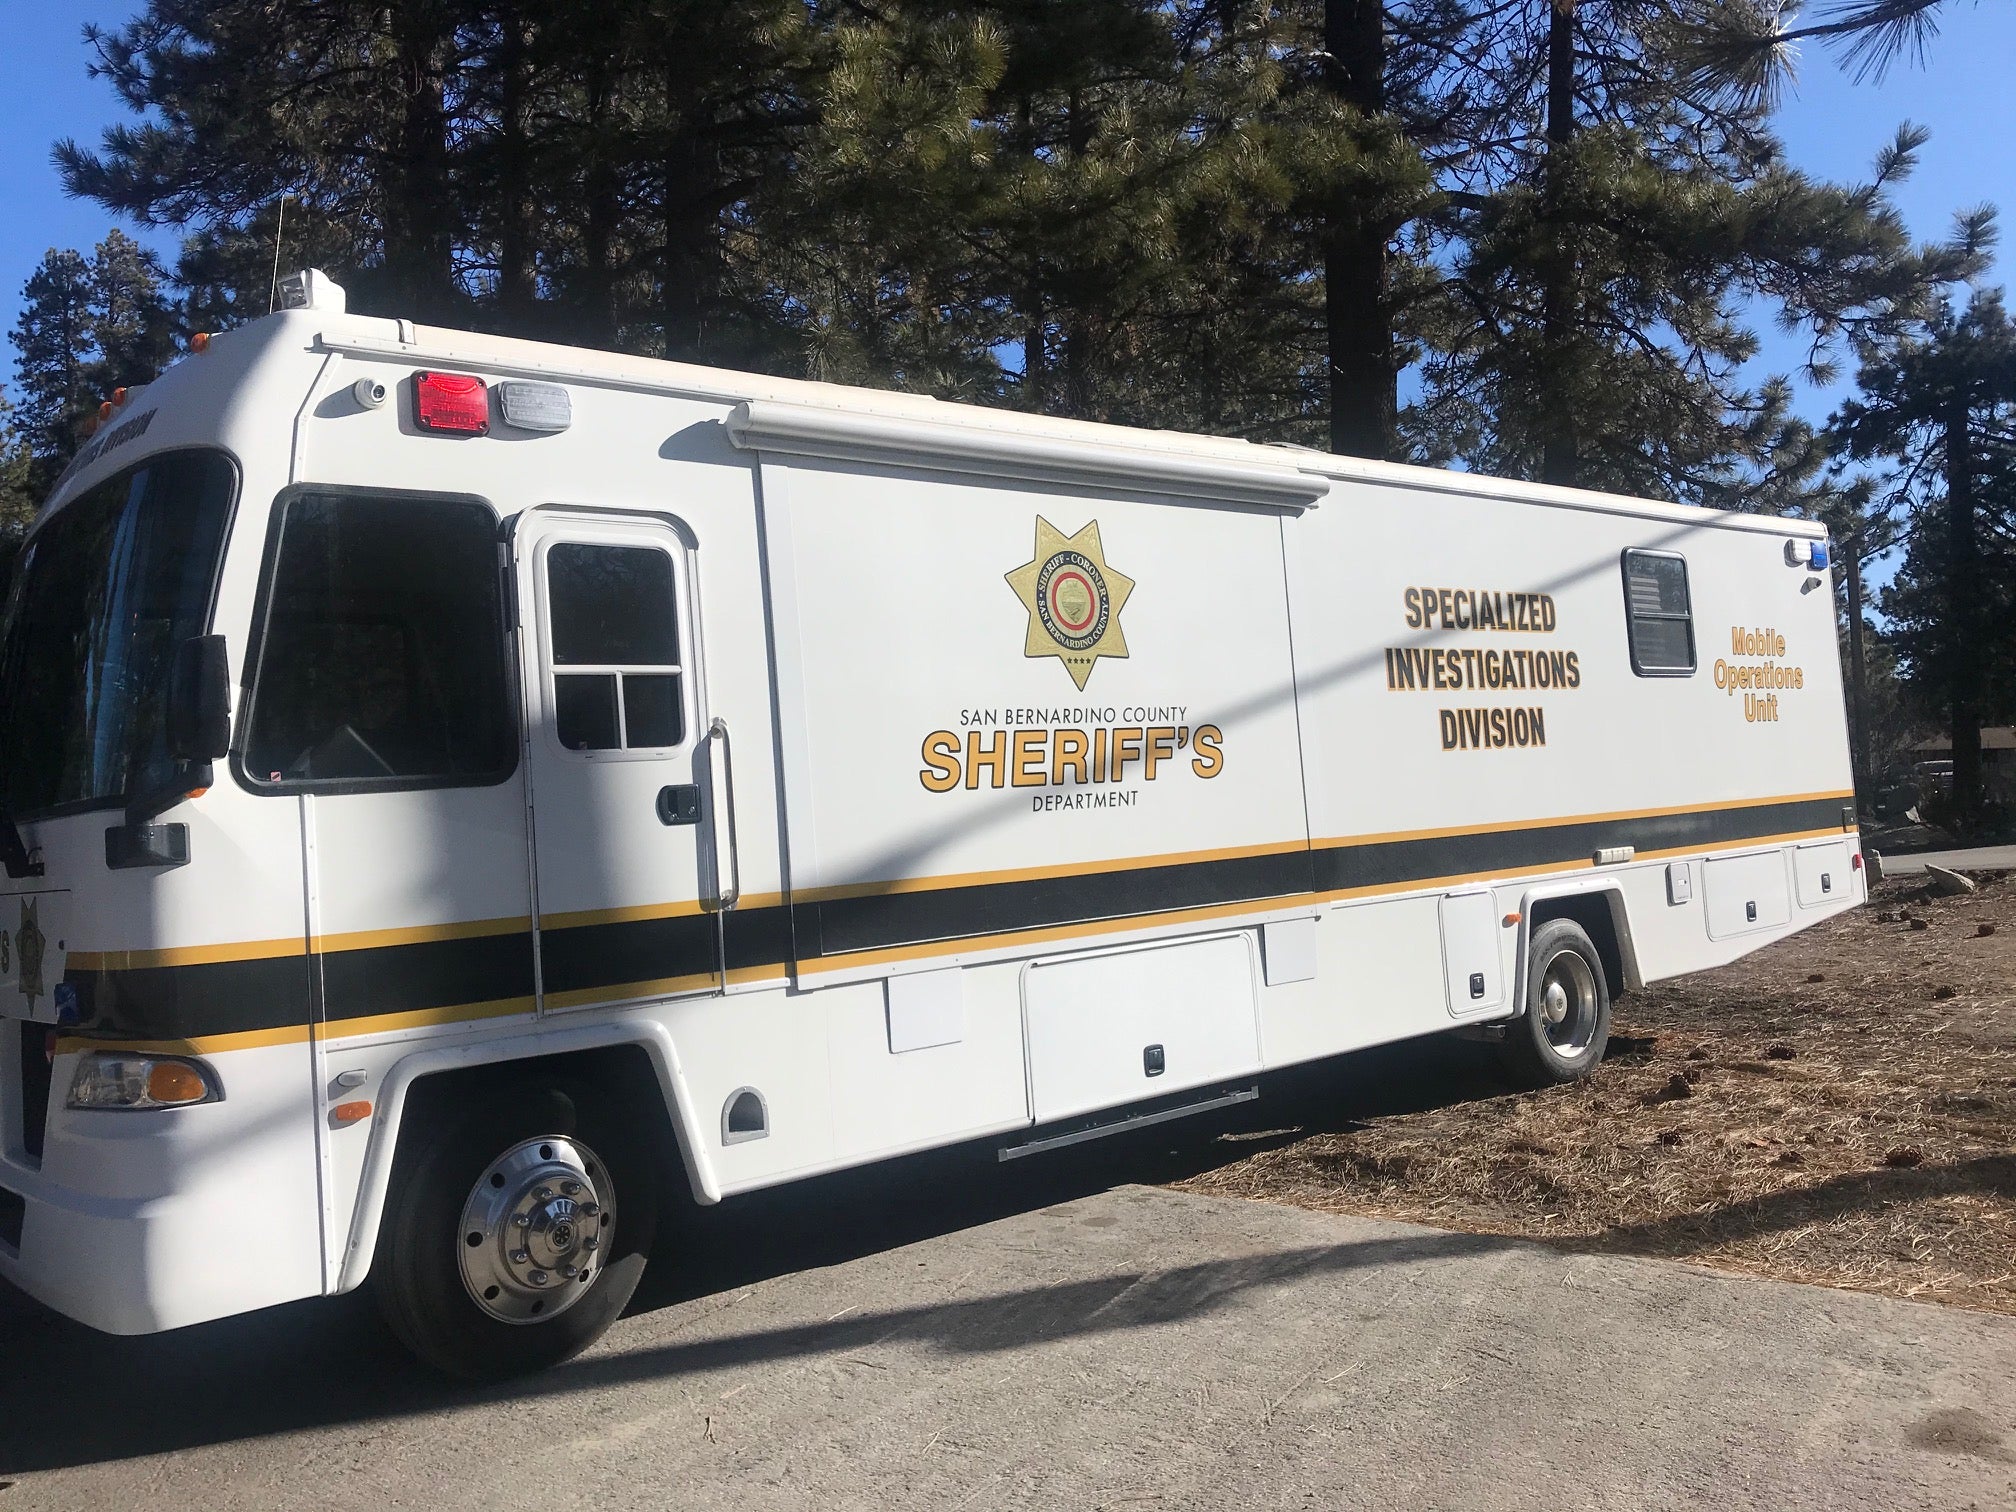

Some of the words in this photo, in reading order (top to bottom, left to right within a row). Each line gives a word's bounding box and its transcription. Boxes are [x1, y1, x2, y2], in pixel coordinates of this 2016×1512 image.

[1038, 553, 1065, 592] SHERIFF
[1070, 553, 1106, 597] CORONER
[1038, 600, 1049, 621] SAN
[1046, 619, 1093, 649] BERNARDINO
[1092, 601, 1109, 639] COUNTY
[1404, 586, 1557, 633] SPECIALIZED
[1731, 626, 1786, 657] Mobile
[1384, 647, 1581, 691] INVESTIGATIONS
[1713, 658, 1804, 696] Operations
[960, 709, 997, 726] SAN
[1005, 707, 1116, 725] BERNARDINO
[1122, 706, 1188, 723] COUNTY
[1439, 706, 1546, 751] DIVISION
[1744, 692, 1779, 722] Unit
[919, 724, 1224, 793] SHERIFF'S
[1032, 790, 1138, 812] DEPARTMENT
